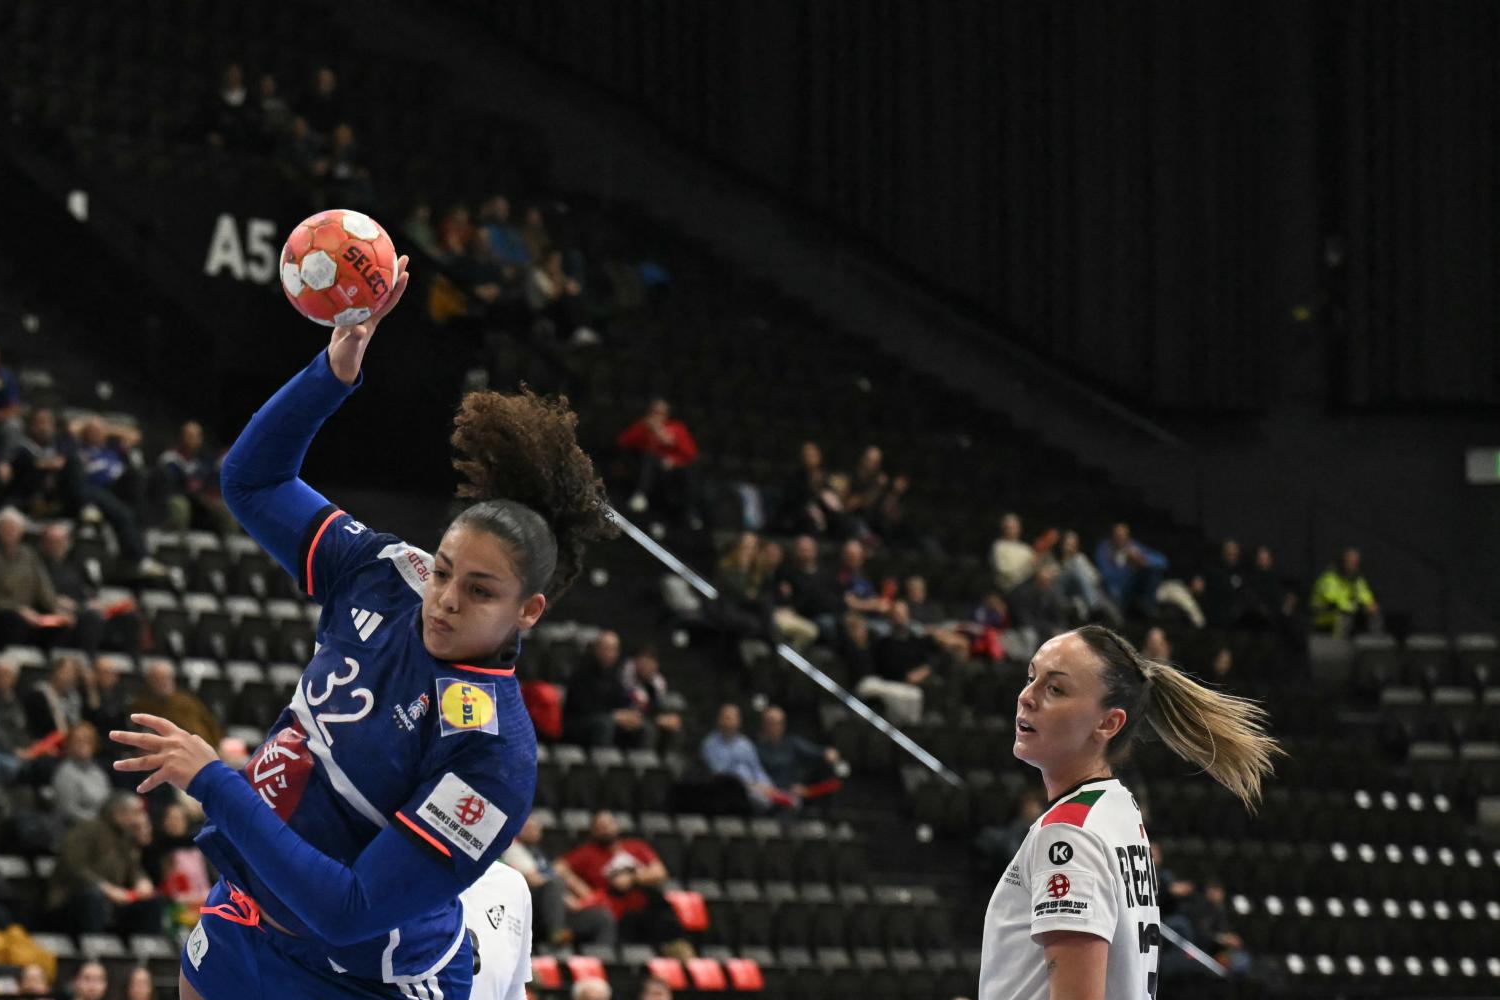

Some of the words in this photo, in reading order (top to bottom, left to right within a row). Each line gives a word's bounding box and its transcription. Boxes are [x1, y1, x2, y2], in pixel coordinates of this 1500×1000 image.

[204, 213, 277, 284] A5
[306, 657, 374, 747] 32
[394, 703, 415, 732] FRANCE
